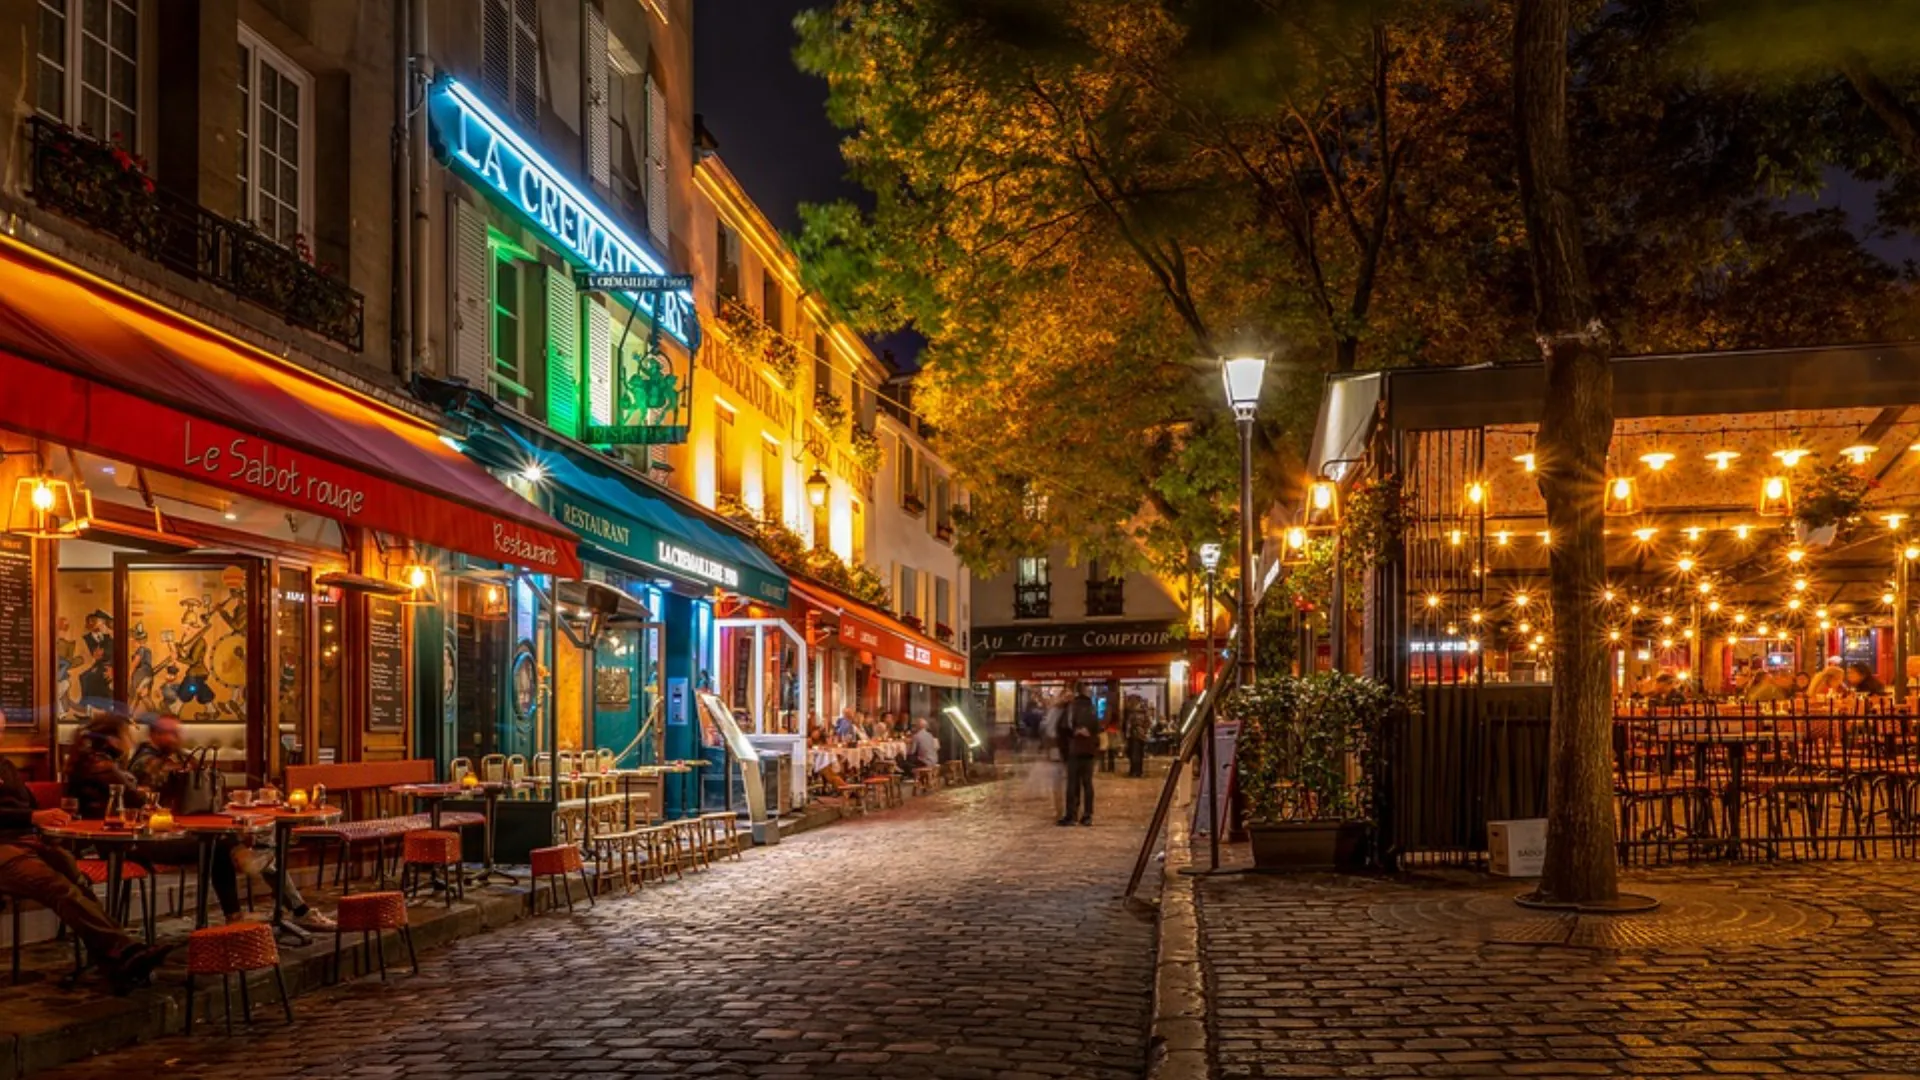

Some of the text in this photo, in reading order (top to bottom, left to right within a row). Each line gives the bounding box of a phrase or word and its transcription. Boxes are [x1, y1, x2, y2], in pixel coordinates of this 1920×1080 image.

[457, 106, 509, 192] LA
[702, 327, 796, 432] RESTAURANT
[183, 419, 365, 518] Le Sabot rouge
[493, 522, 561, 567] Restaurant
[563, 503, 630, 547] RESTAURANT
[1017, 631, 1068, 648] PETIT
[1082, 630, 1170, 647] COMPTOIR
